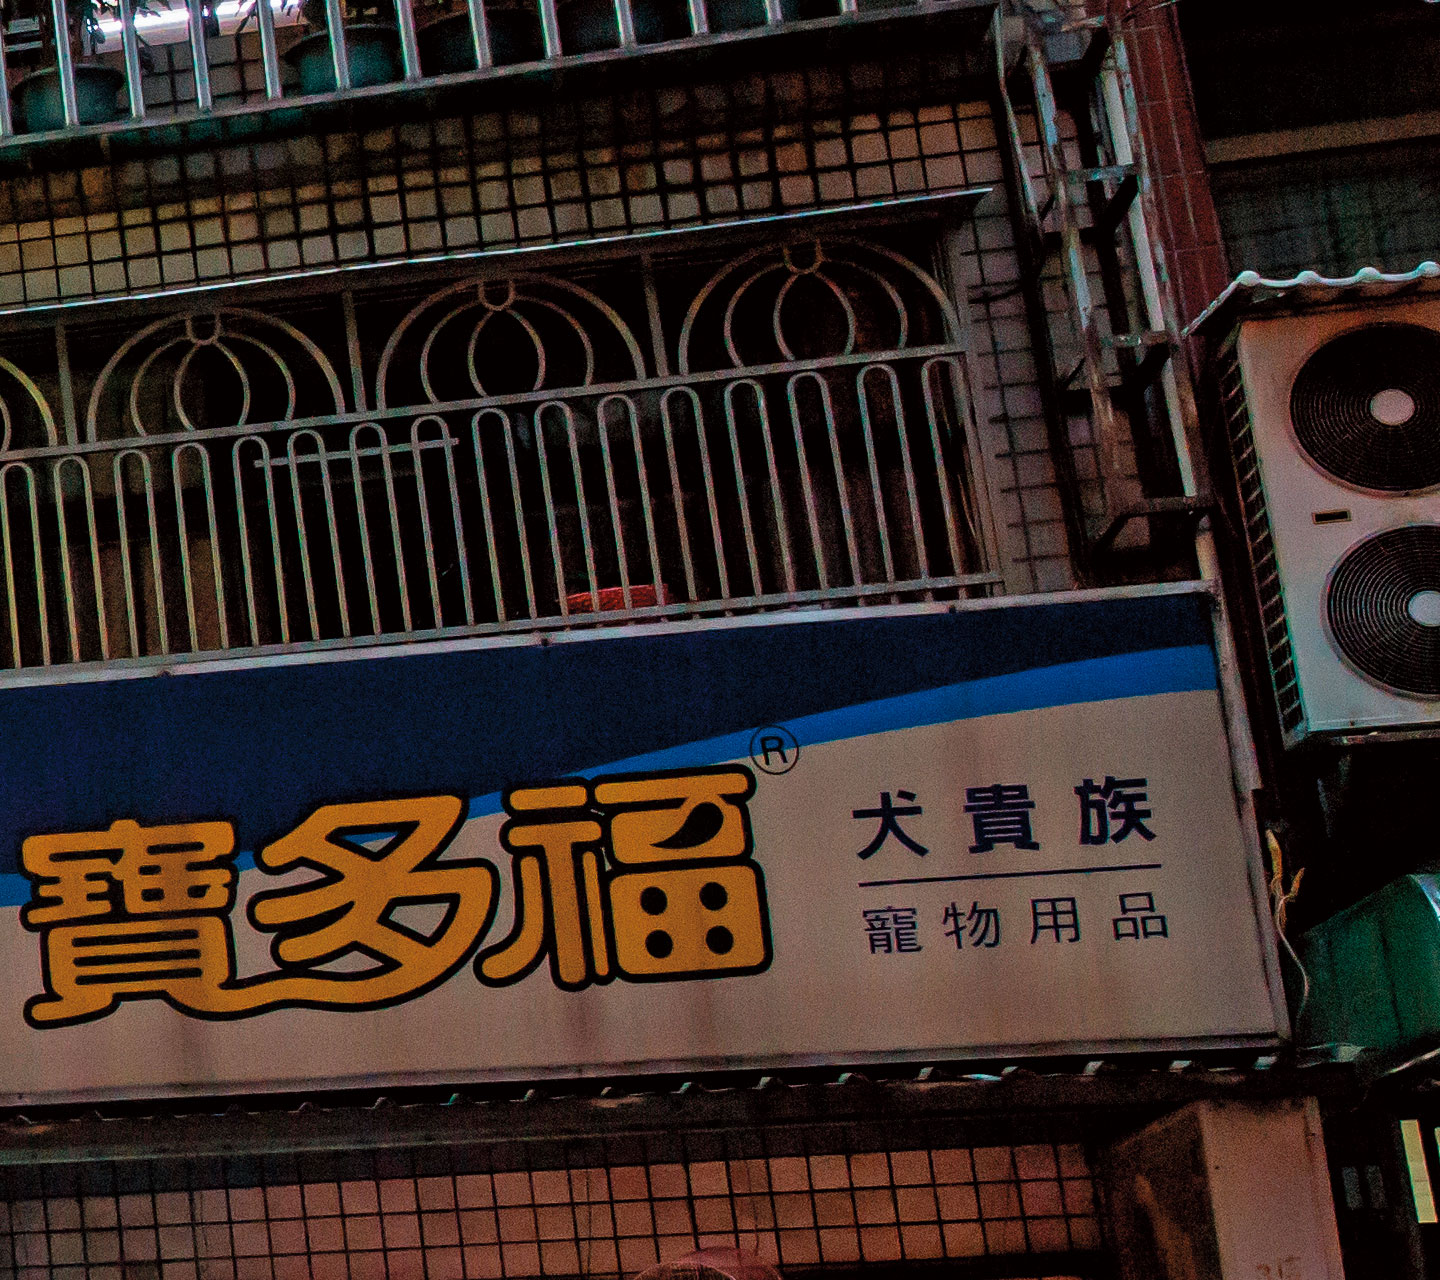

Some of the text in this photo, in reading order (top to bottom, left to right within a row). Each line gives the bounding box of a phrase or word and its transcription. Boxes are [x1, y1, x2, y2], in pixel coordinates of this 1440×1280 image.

[851, 775, 1158, 862] 犬貴族
[17, 764, 775, 1031] 寶多福
[861, 891, 1170, 955] 寵物用品
